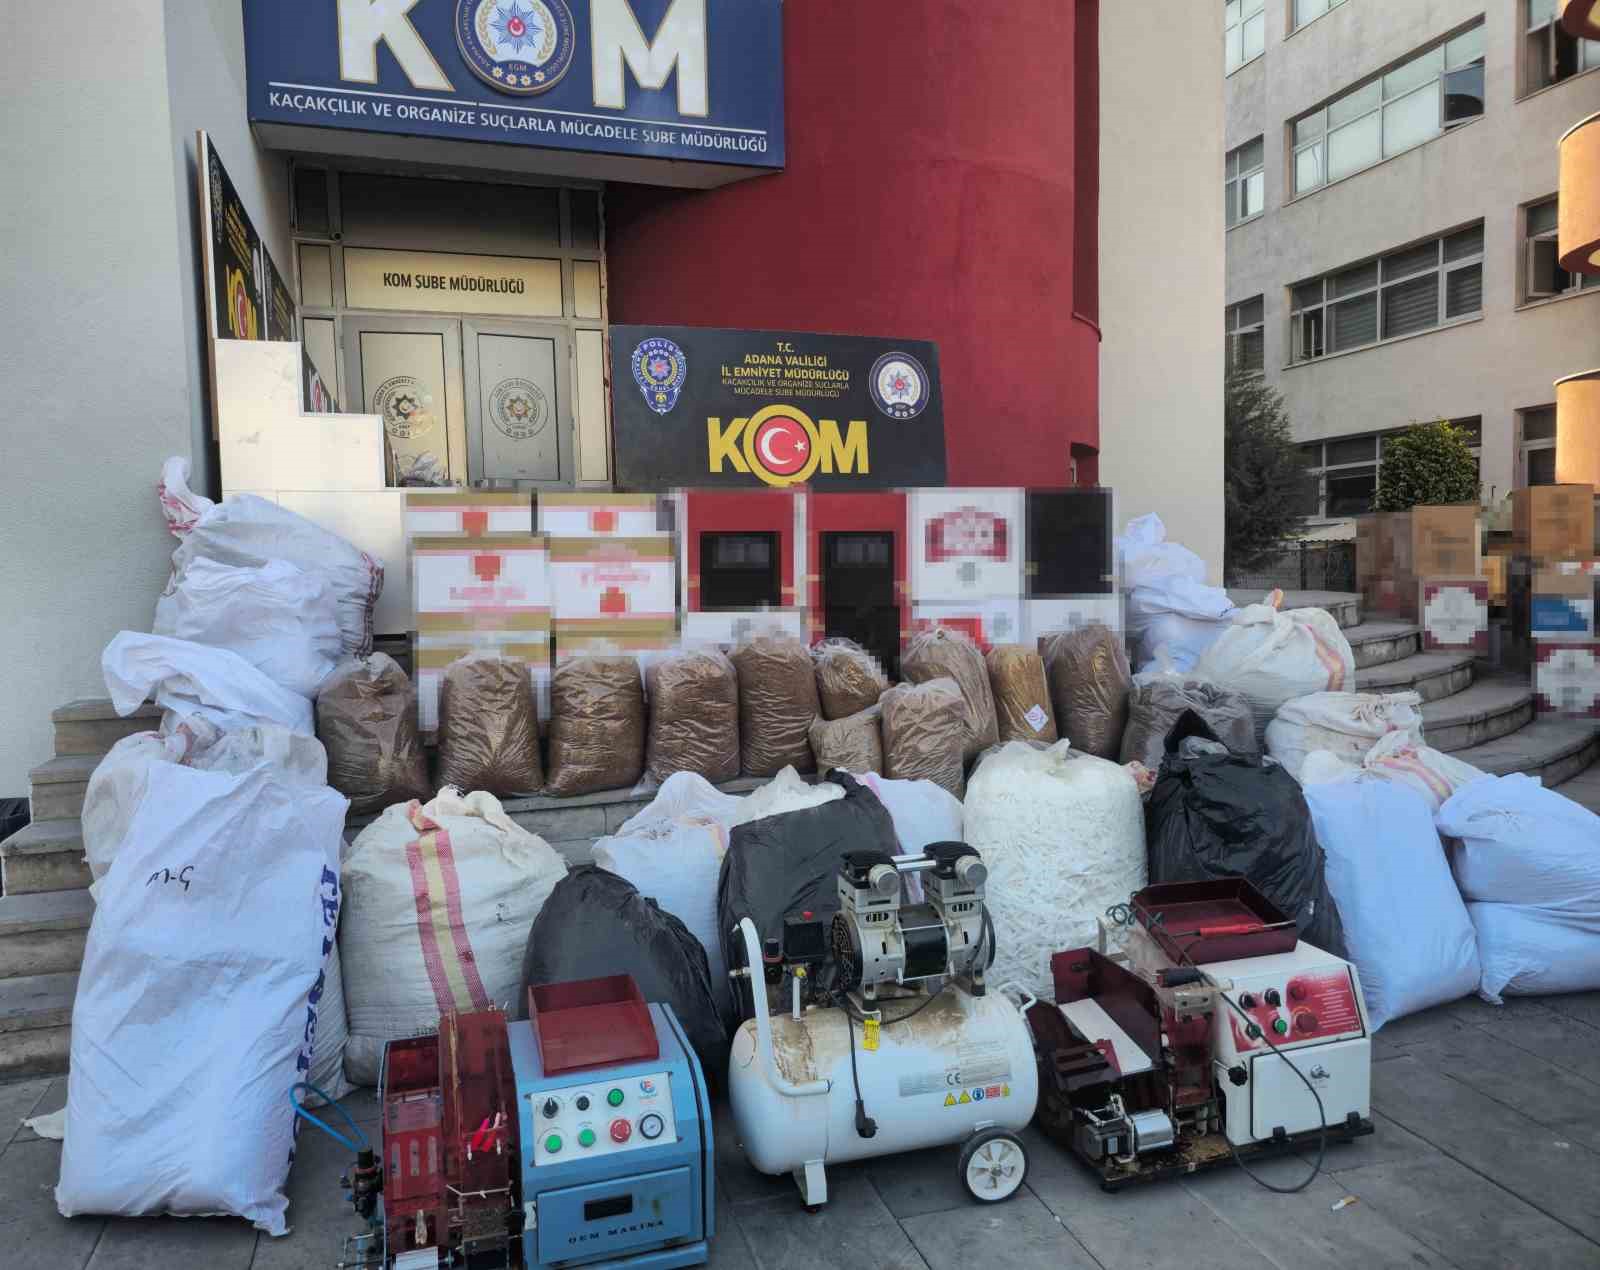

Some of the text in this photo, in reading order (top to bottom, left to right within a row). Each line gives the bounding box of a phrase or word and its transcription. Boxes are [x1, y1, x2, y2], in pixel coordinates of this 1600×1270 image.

[269, 92, 367, 117] KAÇAKÇILIK
[372, 102, 393, 118] VE
[397, 104, 476, 125] ORGANİZE
[480, 113, 556, 133] SUÇLARLA
[560, 119, 638, 141] MÜCADELE
[681, 131, 767, 153] MÜDÜRLÜĞÜ
[383, 272, 412, 288] KOM
[776, 342, 795, 353] T.C.
[744, 354, 782, 366] ADANA
[734, 365, 782, 378] EMNİYET
[707, 404, 870, 488] KOM
